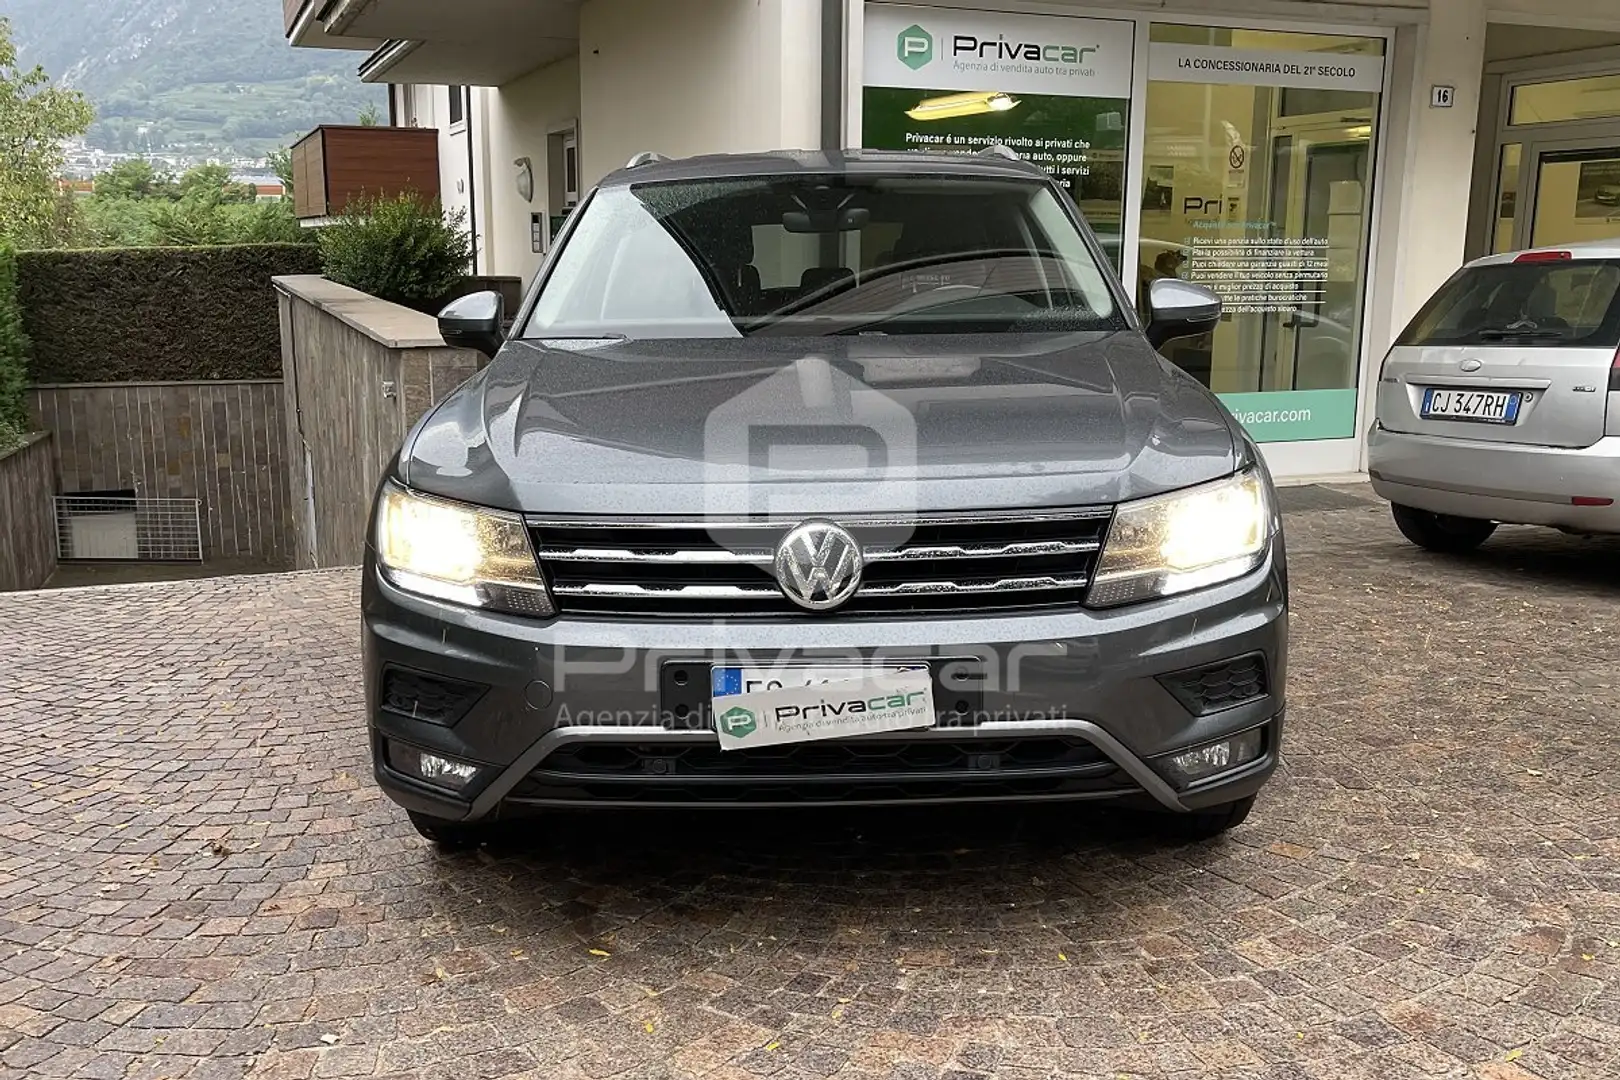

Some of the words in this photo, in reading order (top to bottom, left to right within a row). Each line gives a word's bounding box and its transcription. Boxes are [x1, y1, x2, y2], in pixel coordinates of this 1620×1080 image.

[953, 33, 1097, 64] Privacar
[953, 60, 988, 72] Agenzia
[989, 62, 999, 71] di
[1000, 63, 1033, 74] vendita
[1034, 66, 1054, 75] auto
[1055, 67, 1067, 76] tra
[1069, 68, 1096, 78] privati
[1178, 57, 1192, 69] LA
[1193, 59, 1282, 74] CONCESSIONARIA
[1283, 64, 1301, 75] DEL
[1317, 66, 1356, 78] SECOLO
[1436, 88, 1449, 103] 16
[905, 132, 944, 144] Privacar
[954, 136, 966, 144] un
[967, 134, 1003, 145] servizio
[1004, 135, 1034, 147] rivolto
[1035, 137, 1044, 147] ai
[1044, 137, 1073, 149] privati
[1073, 138, 1090, 149] che
[1032, 151, 1055, 162] auto,
[1057, 154, 1087, 164] oppure
[1061, 166, 1090, 176] servizi
[1183, 193, 1223, 214] Pri
[1454, 391, 1509, 417] 347RH
[1231, 408, 1312, 424] ivacar.com
[774, 690, 926, 722] Privacar
